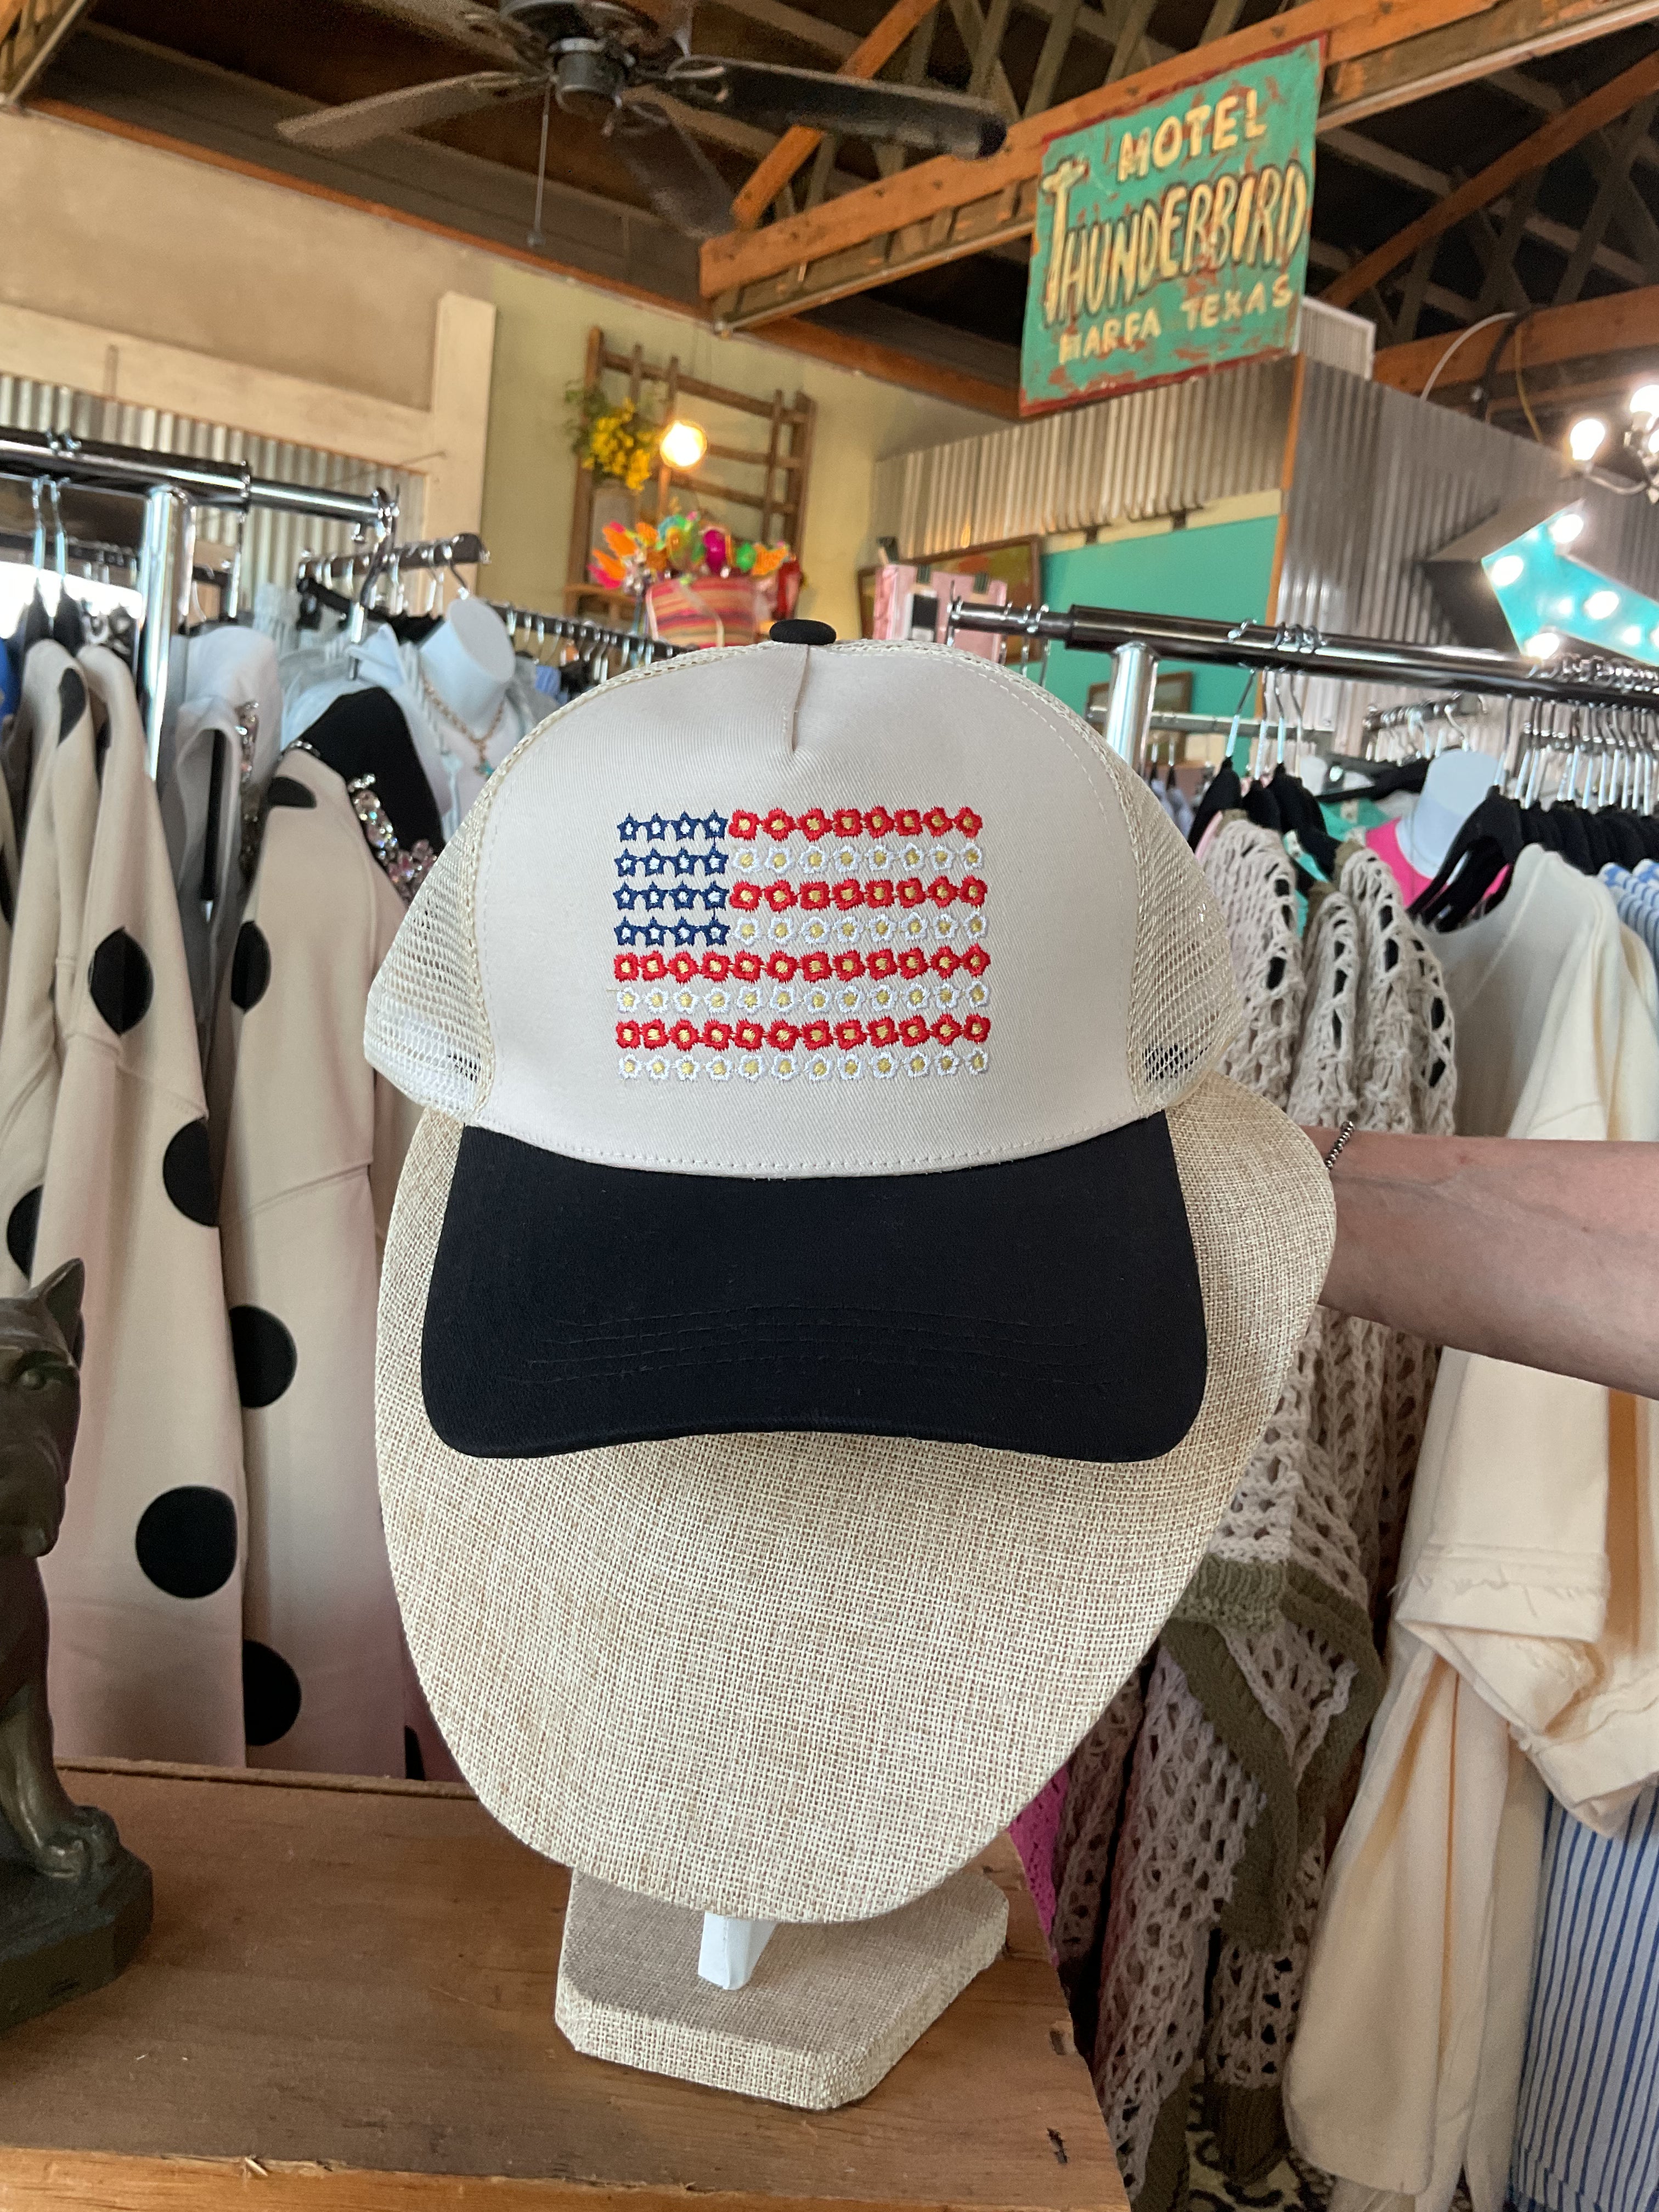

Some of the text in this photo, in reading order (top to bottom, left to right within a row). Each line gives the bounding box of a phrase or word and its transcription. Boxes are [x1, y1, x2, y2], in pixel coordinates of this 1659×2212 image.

[1118, 89, 1267, 182] MOTEL
[1042, 159, 1307, 325] THUNDERBIRD
[1059, 274, 1293, 364] MARFA TEXAS
